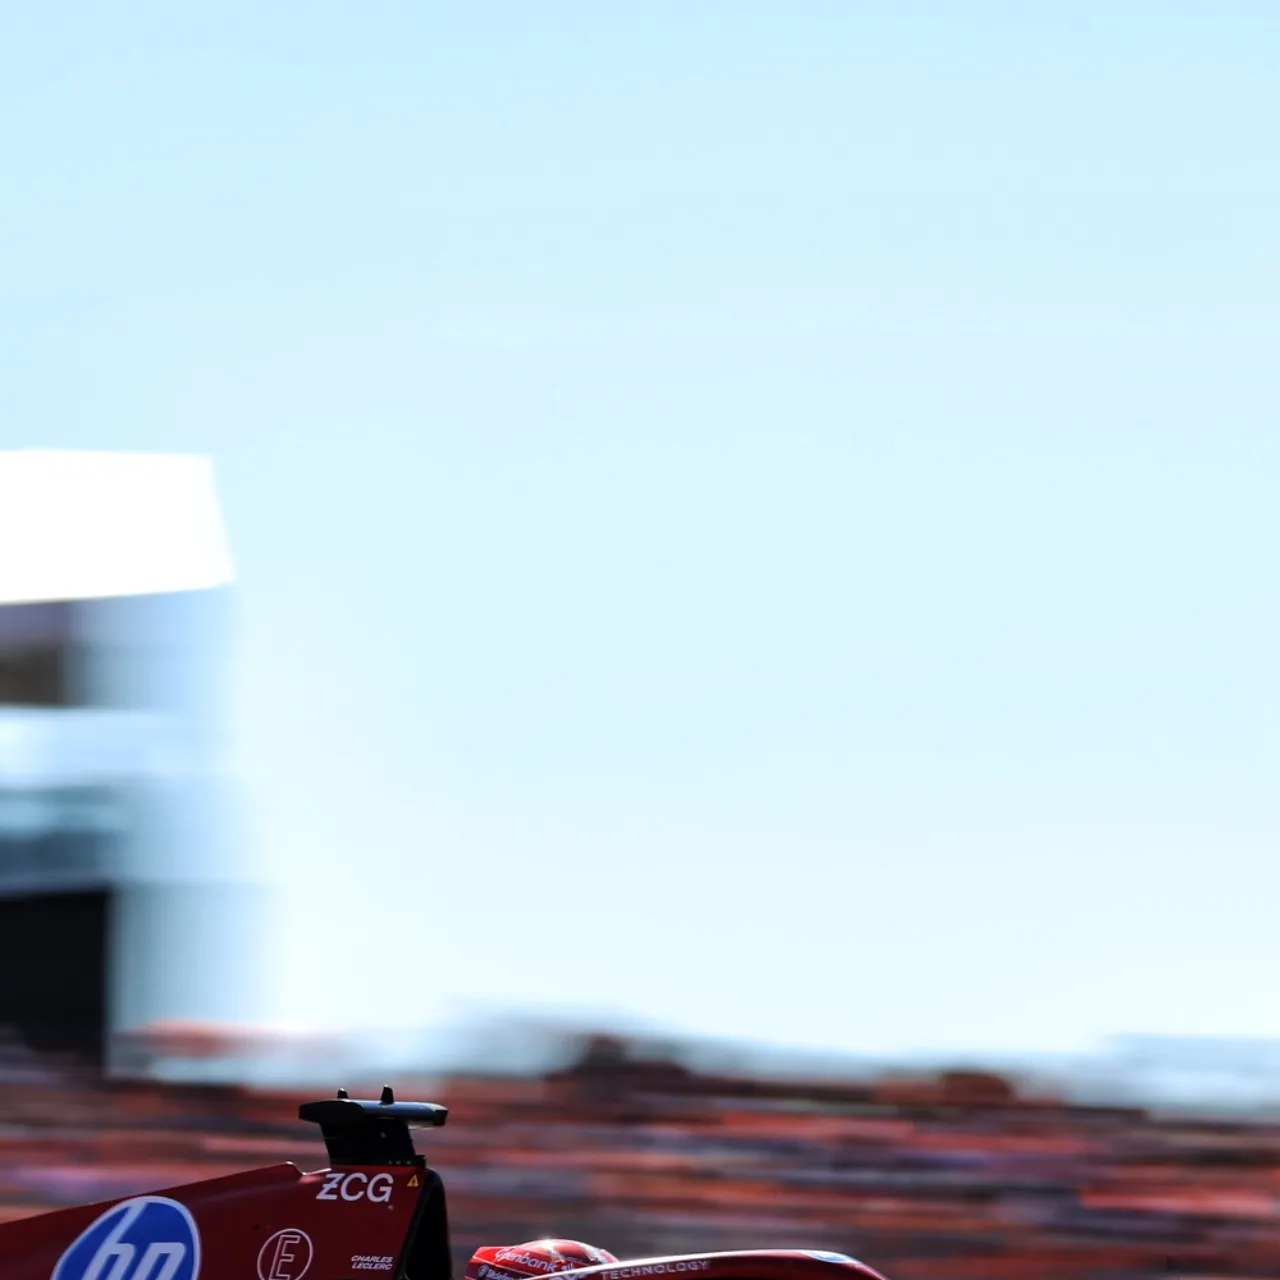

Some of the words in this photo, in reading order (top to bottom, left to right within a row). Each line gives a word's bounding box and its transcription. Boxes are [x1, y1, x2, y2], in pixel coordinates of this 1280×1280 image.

[316, 1172, 394, 1203] ZCG
[351, 1255, 393, 1263] CHARLES
[352, 1262, 393, 1270] LECLERC
[600, 1259, 710, 1280] TECHNOLOGY
